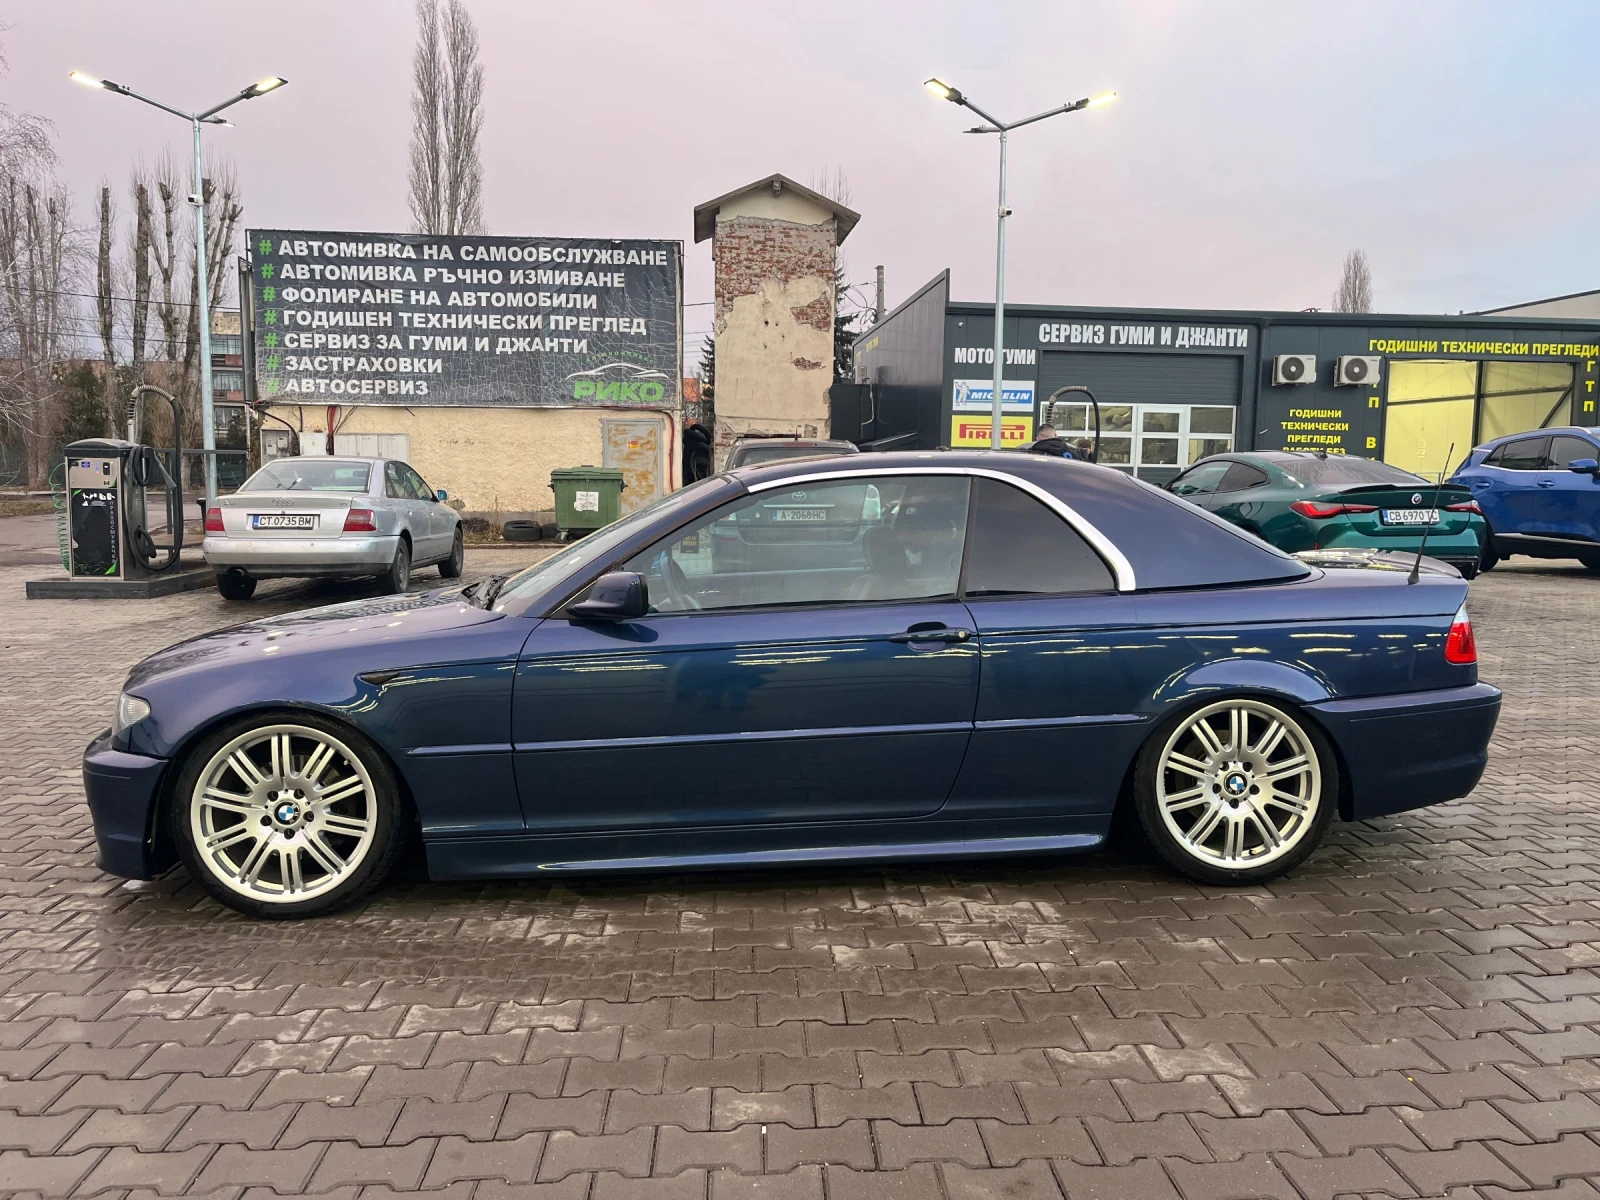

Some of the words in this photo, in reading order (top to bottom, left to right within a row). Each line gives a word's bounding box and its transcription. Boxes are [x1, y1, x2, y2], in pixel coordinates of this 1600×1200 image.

[278, 240, 417, 259] АВТОМИВКА
[423, 244, 454, 260] НА
[460, 245, 668, 266] САМООБСЛУЖВАНЕ
[280, 263, 417, 282] АВТОМИВКА
[424, 268, 503, 284] РЪЧНО
[510, 269, 625, 288] ИЗМИВАНЕ
[281, 287, 404, 304] ФОЛИРАНЕ
[410, 289, 441, 306] НА
[447, 291, 597, 309] АВТОМОБИЛИ
[283, 310, 393, 328] ГОДИШЕН
[398, 312, 543, 330] ТЕХНИЧЕСКИ
[550, 315, 647, 335] ПРЕГЛЕД
[284, 333, 370, 349] СЕРВИЗ
[376, 334, 402, 350] ЗА
[408, 335, 467, 351] ГУМИ
[475, 337, 489, 352] И
[495, 337, 588, 355] ДЖАНТИ
[1038, 323, 1105, 344] СЕРВИЗ
[1109, 325, 1155, 345] ГУМИ
[1160, 326, 1171, 346] И
[1175, 326, 1249, 349] ДЖАНТИ
[954, 347, 994, 364] МОТО
[1369, 339, 1438, 354] ГОДИШНИ
[1442, 341, 1529, 355] ТЕХНИЧЕСКИ
[1532, 343, 1600, 358] ПРЕГЛЕДИ
[285, 356, 443, 373] ЗАСТРАХОВКИ
[284, 378, 429, 395] АВТОСЕРВИЗ
[573, 380, 665, 402] РИКО
[971, 391, 1031, 401] MICELIN
[1289, 409, 1342, 419] ГОДИШНИ
[1281, 421, 1349, 431] ТЕХНИЧЕСКИ
[1287, 434, 1342, 444] ПРЕГЛЕДИ
[1403, 511, 1425, 521] 6970
